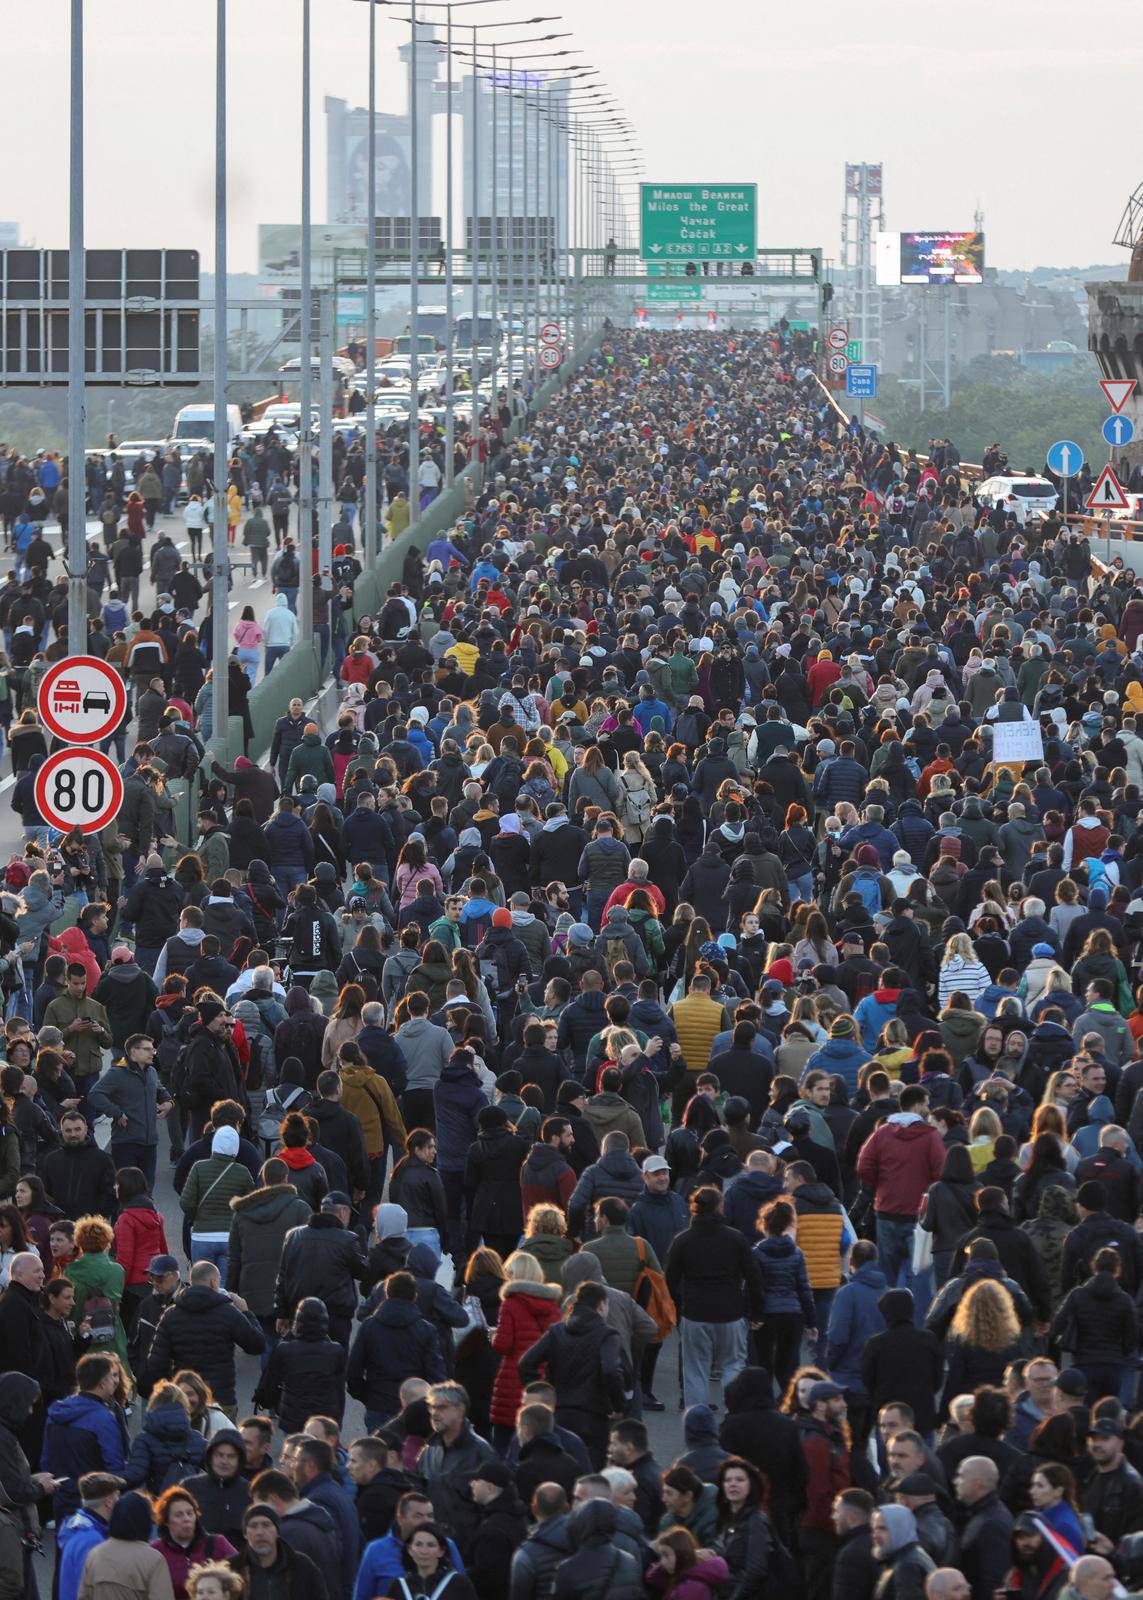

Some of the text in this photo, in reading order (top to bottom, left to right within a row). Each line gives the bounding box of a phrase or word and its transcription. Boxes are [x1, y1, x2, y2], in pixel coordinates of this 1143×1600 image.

[653, 190, 744, 200] Милош Велики
[689, 201, 708, 212] the
[717, 201, 749, 212] Great
[680, 216, 716, 226] Чачак
[680, 226, 716, 239] Čačak
[832, 357, 845, 370] 80
[852, 377, 871, 385] Сава
[852, 385, 870, 394] Sava
[53, 768, 105, 813] 80
